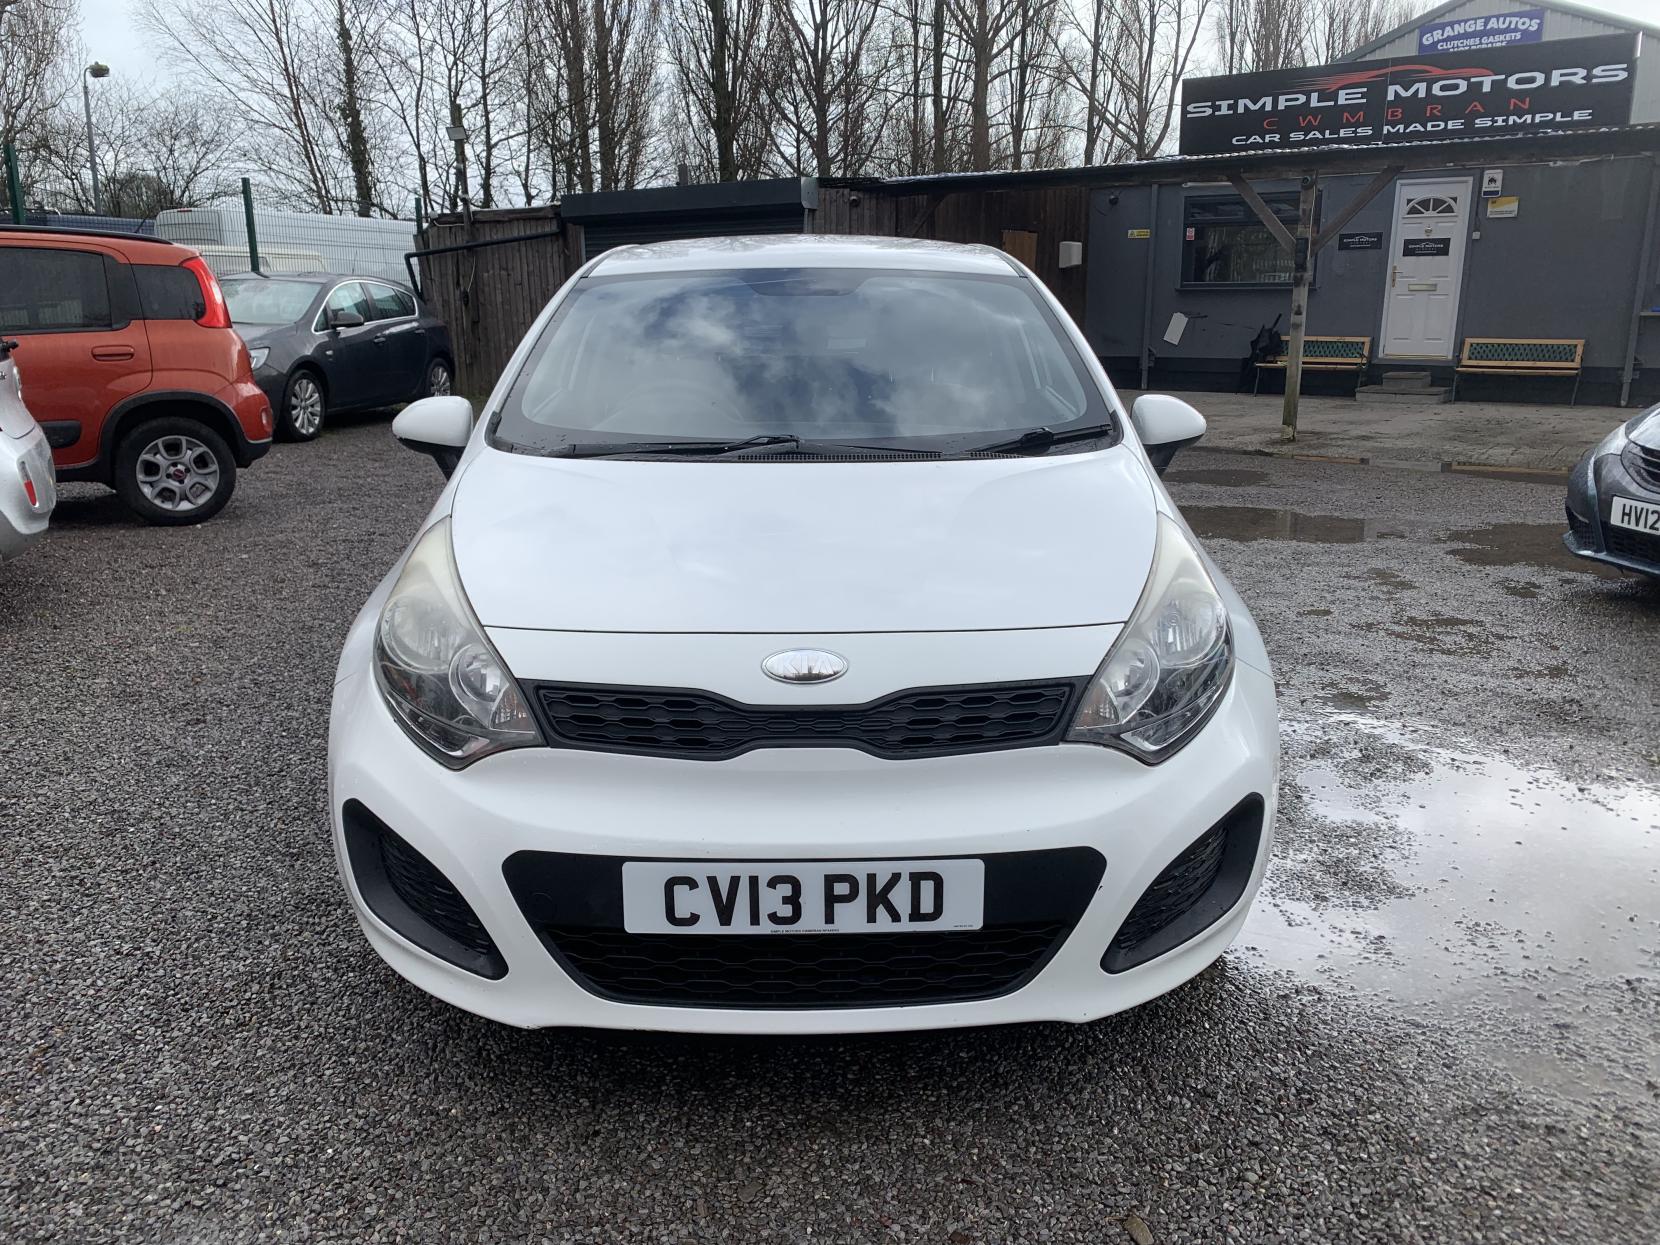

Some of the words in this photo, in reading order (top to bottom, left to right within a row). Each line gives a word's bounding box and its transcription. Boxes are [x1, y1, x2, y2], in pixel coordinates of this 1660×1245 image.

[1422, 19, 1485, 45] GRANGE
[1486, 16, 1541, 31] AUTOS
[1437, 38, 1480, 50] CLUTCHES
[1481, 32, 1522, 43] GASKETS
[1186, 87, 1367, 118] SIMPLE
[1387, 63, 1629, 101] MOTORS
[1231, 133, 1281, 145] CAR
[1289, 126, 1373, 141] SALES
[1383, 119, 1465, 134] MADE
[1474, 109, 1593, 128] SIMPLE
[1263, 97, 1530, 129] CWMBRAN
[1621, 503, 1660, 531] HV12
[664, 874, 803, 927] CV13
[824, 871, 944, 925] PKD
